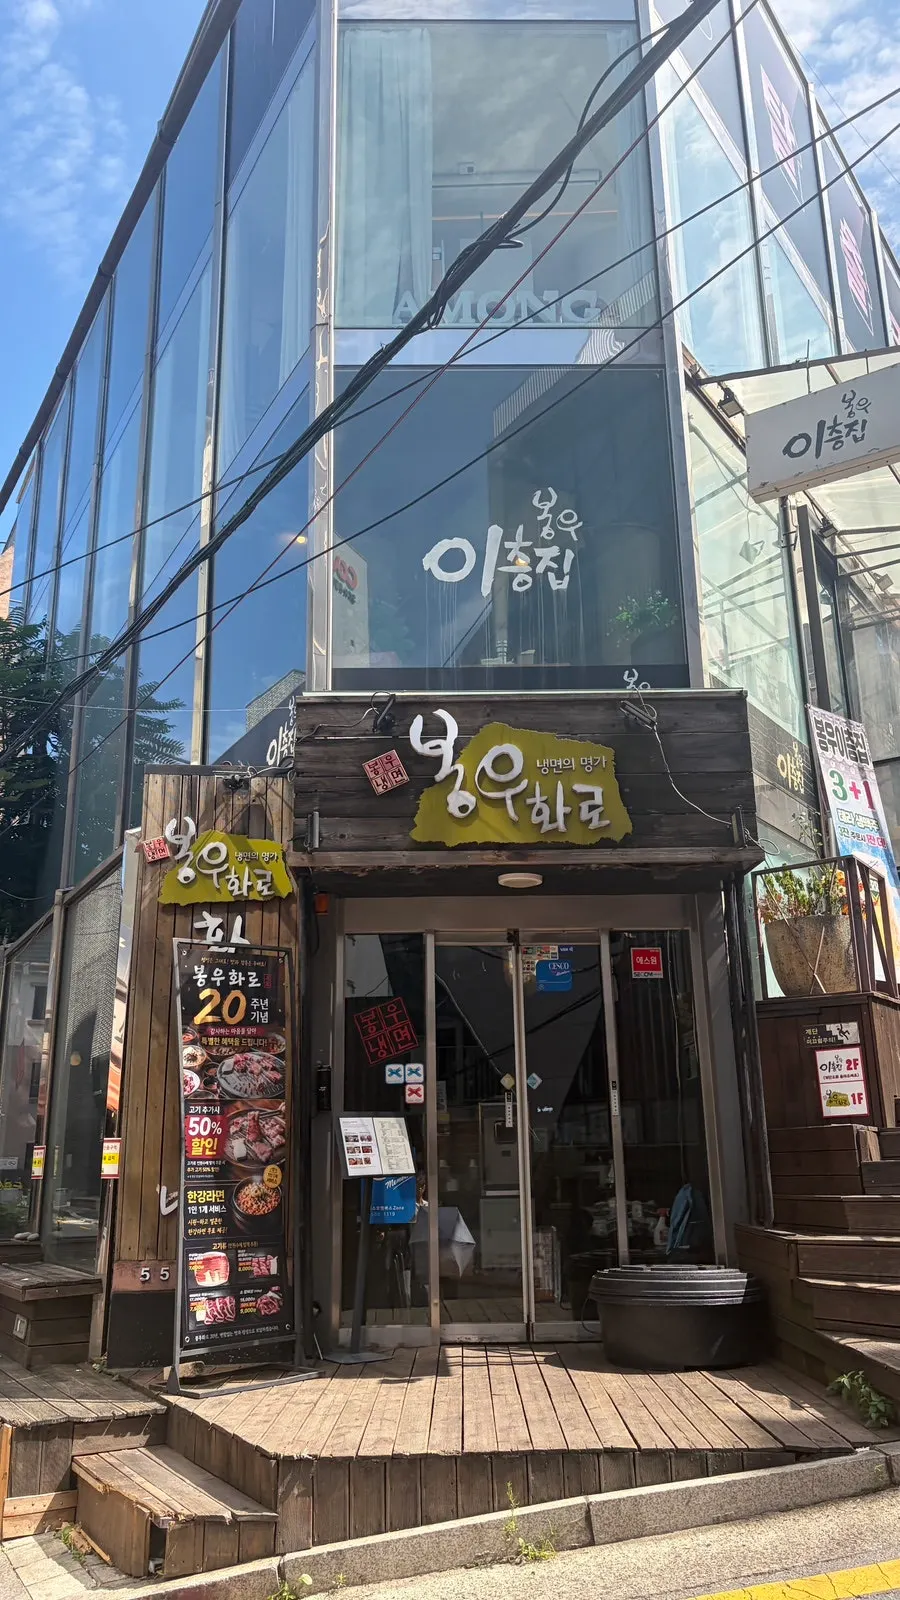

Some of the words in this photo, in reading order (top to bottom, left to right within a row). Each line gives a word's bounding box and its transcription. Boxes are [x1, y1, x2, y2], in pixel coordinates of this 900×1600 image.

[841, 389, 872, 418] 봉우
[782, 414, 868, 460] 이층집
[532, 487, 583, 541] 봉우
[422, 524, 575, 598] 이층집
[814, 716, 870, 766] 봉우이층집
[536, 758, 576, 775] 냉면의
[580, 755, 608, 773] 명가
[829, 769, 876, 811] 3+1
[234, 850, 259, 863] 냉면의
[261, 851, 278, 863] 명가
[548, 961, 570, 971] CESCO
[635, 956, 657, 965] 에스원
[193, 965, 261, 988] 봉우화로
[193, 988, 247, 1025] 20
[250, 998, 269, 1010] 주년
[250, 1011, 269, 1024] 기념
[805, 1028, 818, 1036] 계단
[201, 1037, 220, 1046] 특별한
[221, 1037, 240, 1046] 혜택을
[241, 1038, 268, 1047] 드립니다!
[845, 1058, 859, 1071] 2F
[850, 1092, 864, 1105] 1F
[189, 1106, 201, 1114] 고기
[202, 1106, 220, 1114] 추가시
[188, 1117, 222, 1136] 50%
[191, 1137, 218, 1156] 할인
[186, 1190, 225, 1203] 한강라면
[188, 1206, 198, 1214] 1인
[198, 1206, 208, 1214] 1개
[208, 1205, 227, 1214] 서비스
